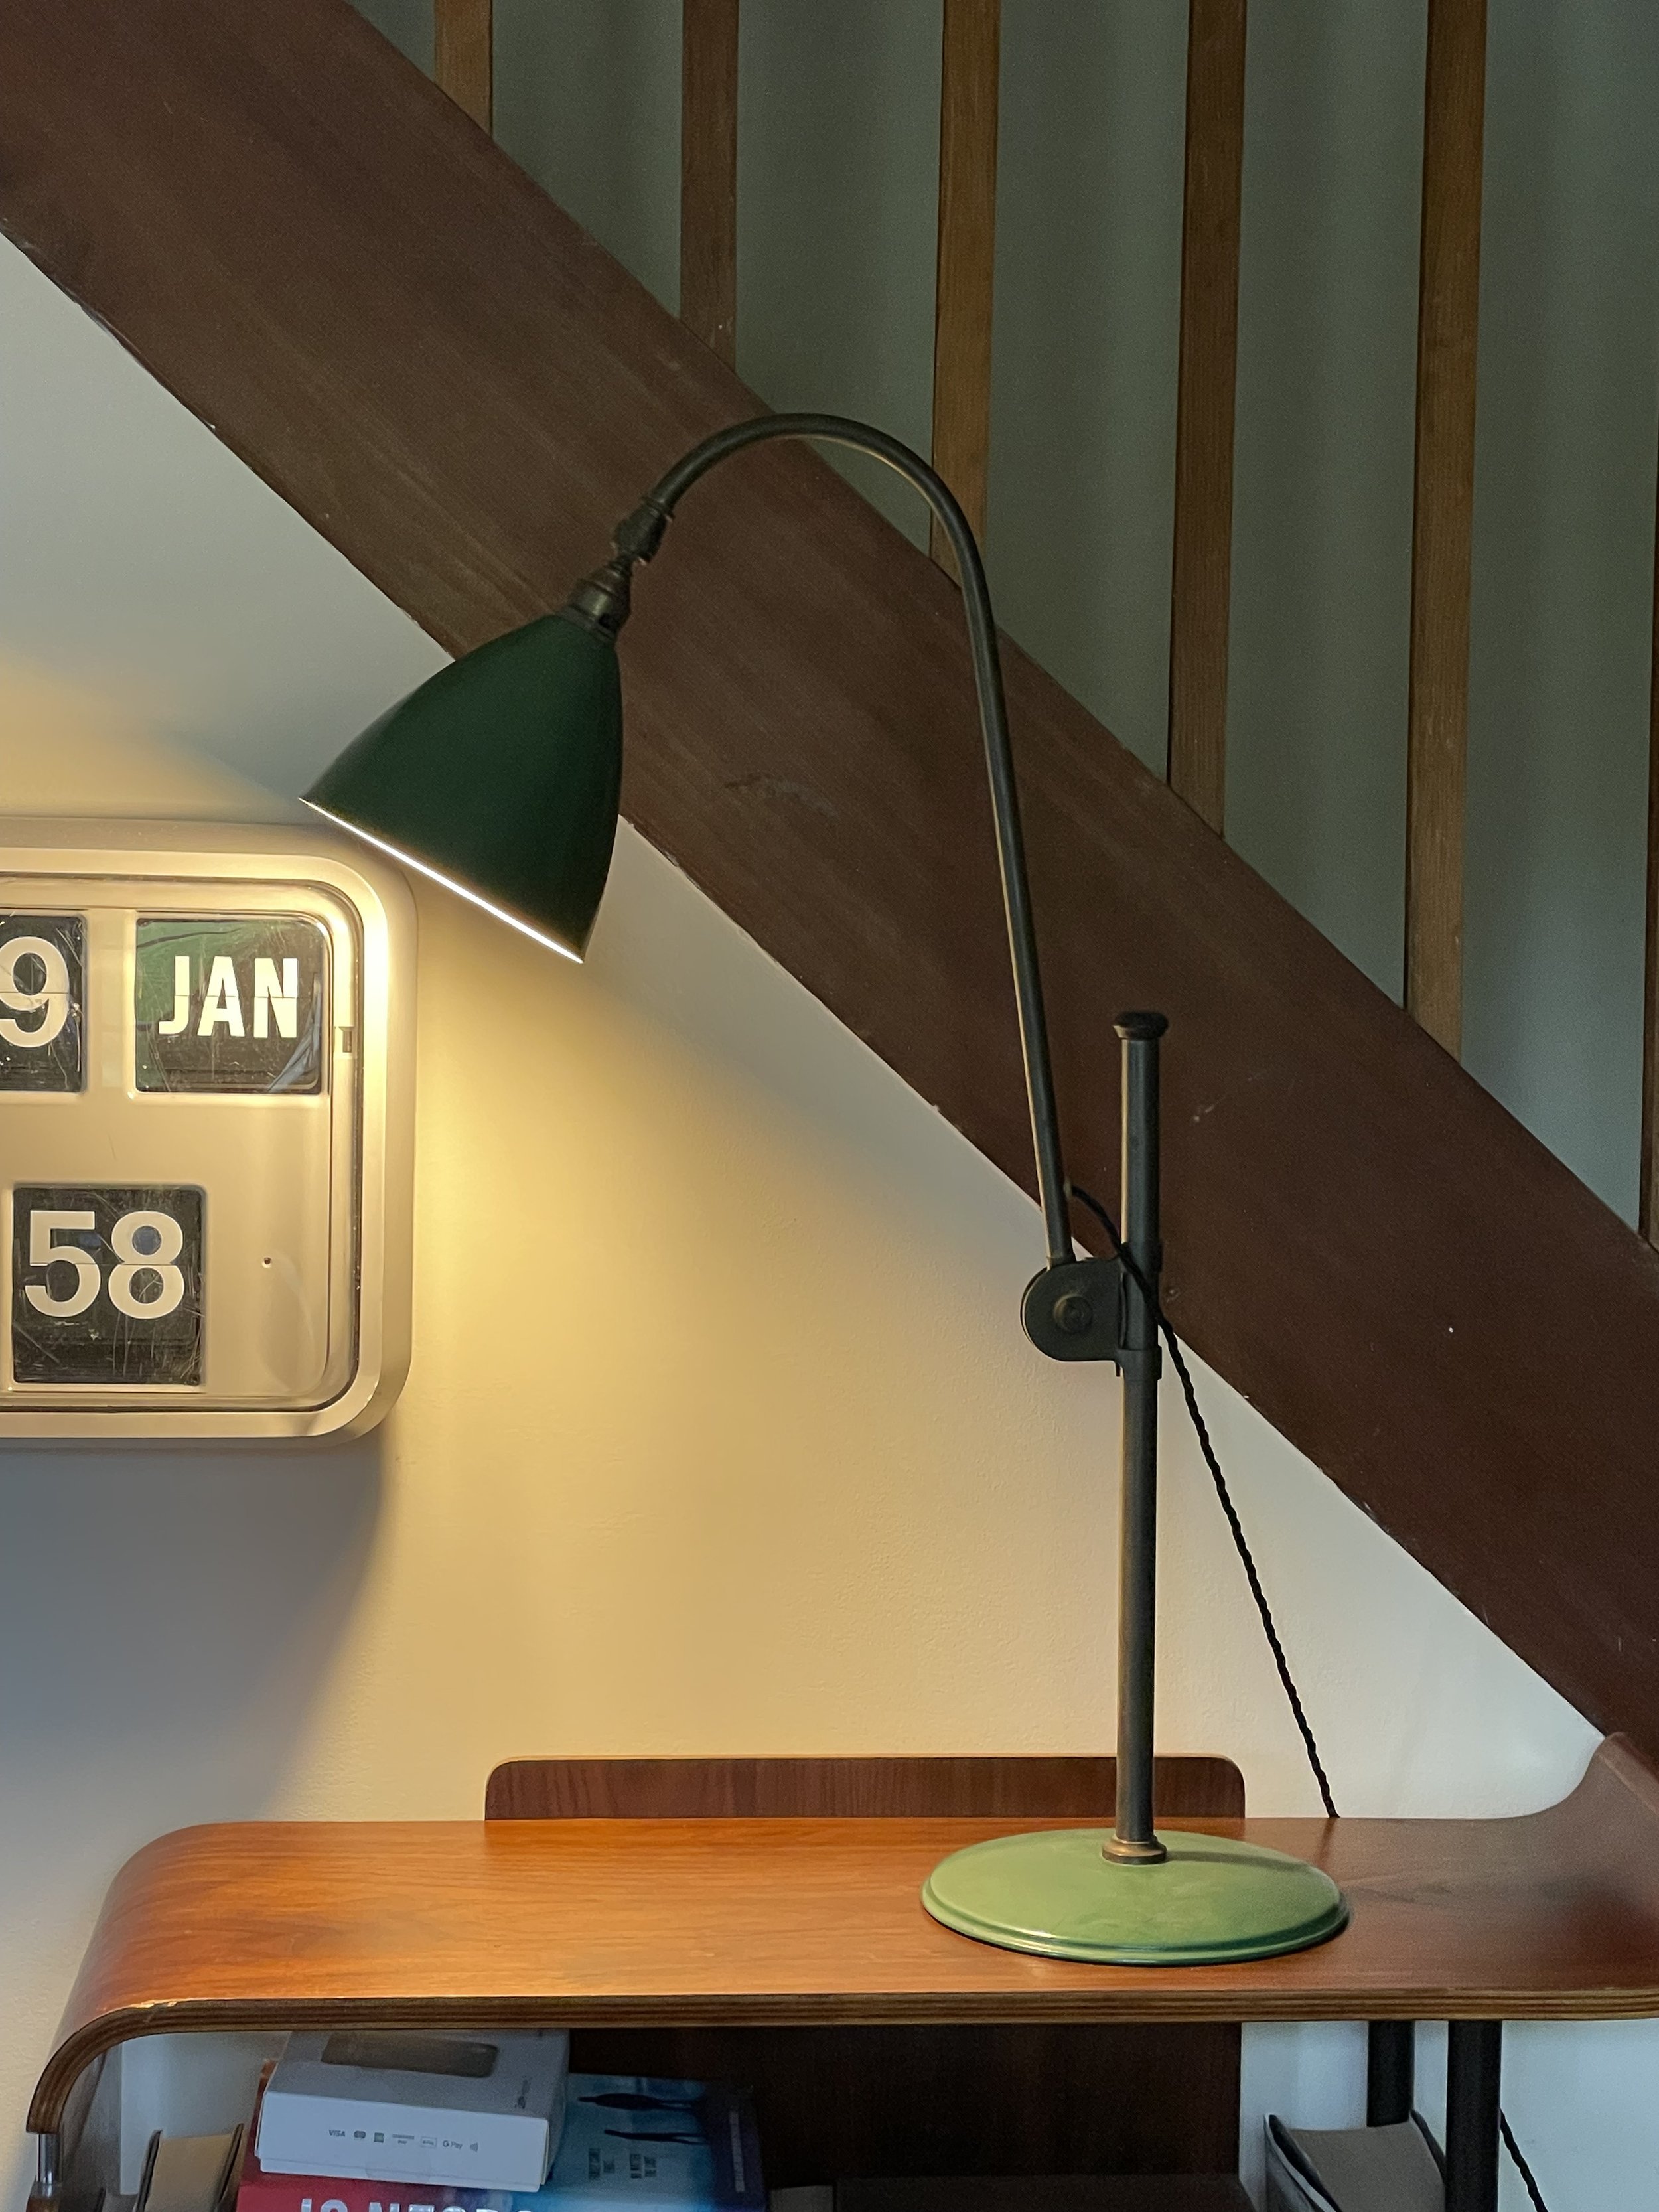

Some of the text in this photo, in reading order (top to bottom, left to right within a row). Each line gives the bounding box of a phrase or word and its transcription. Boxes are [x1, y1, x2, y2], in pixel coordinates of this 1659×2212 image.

[0, 936, 299, 1047] 9 JAN
[24, 1209, 185, 1319] 58
